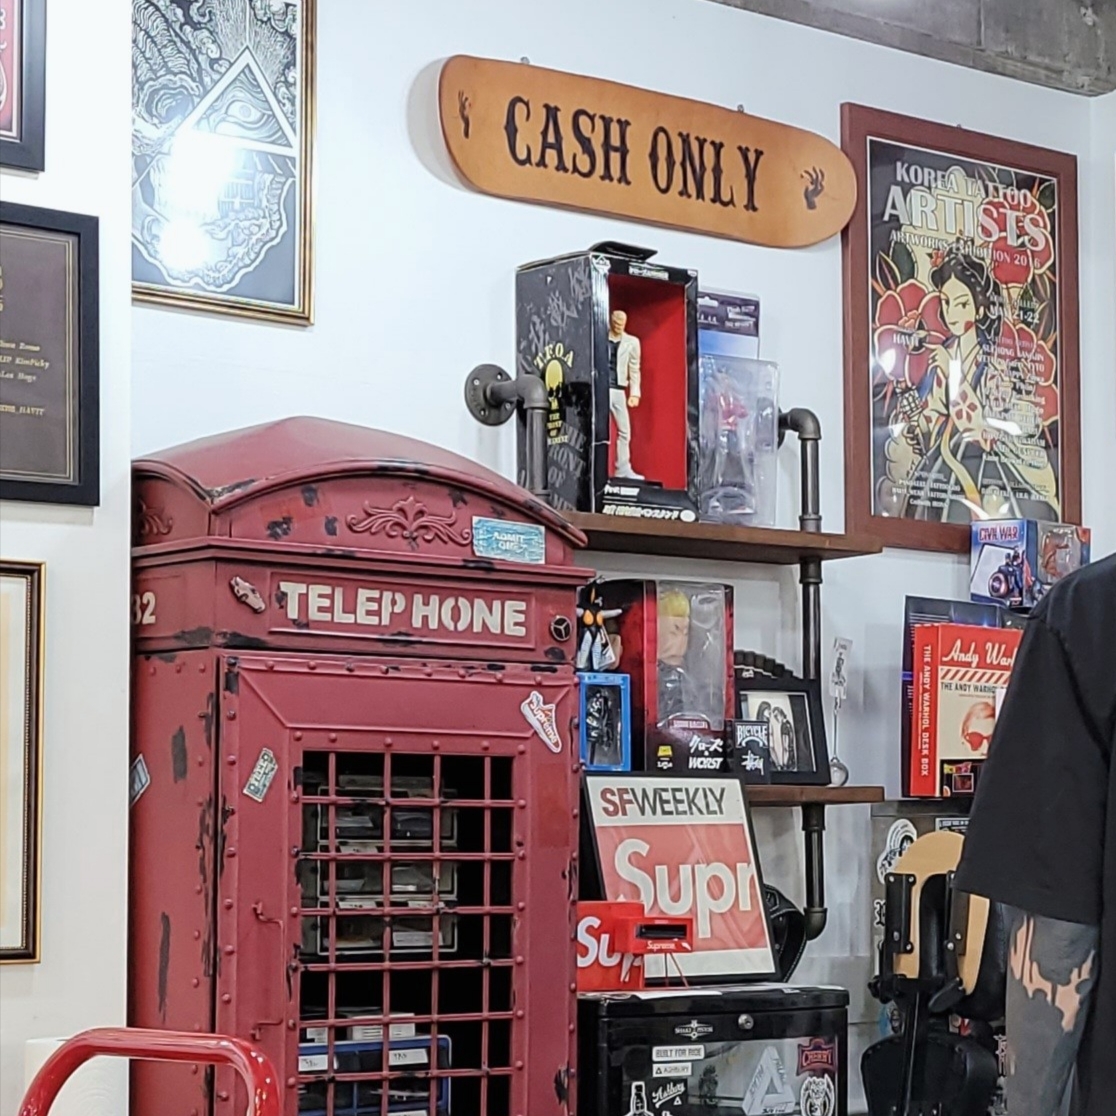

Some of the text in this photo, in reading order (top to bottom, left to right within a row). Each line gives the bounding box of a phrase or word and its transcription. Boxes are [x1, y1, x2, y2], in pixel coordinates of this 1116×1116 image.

[504, 96, 764, 212] CASH ONLY
[896, 161, 1032, 208] KOREA TATTOO
[883, 184, 1046, 251] ARTISTS
[889, 229, 949, 250] ARTWORKS
[979, 526, 1018, 542] CIVIL WAR
[279, 581, 527, 637] TELEPHONE
[942, 640, 980, 667] Andy
[941, 682, 953, 691] THE
[955, 683, 974, 692] ANDY
[920, 645, 931, 776] THE ANDY WARHOL DESK BOX
[737, 724, 768, 745] BICYCLE
[688, 757, 724, 769] WORST
[656, 1047, 702, 1058] BUILT FOR RIDE
